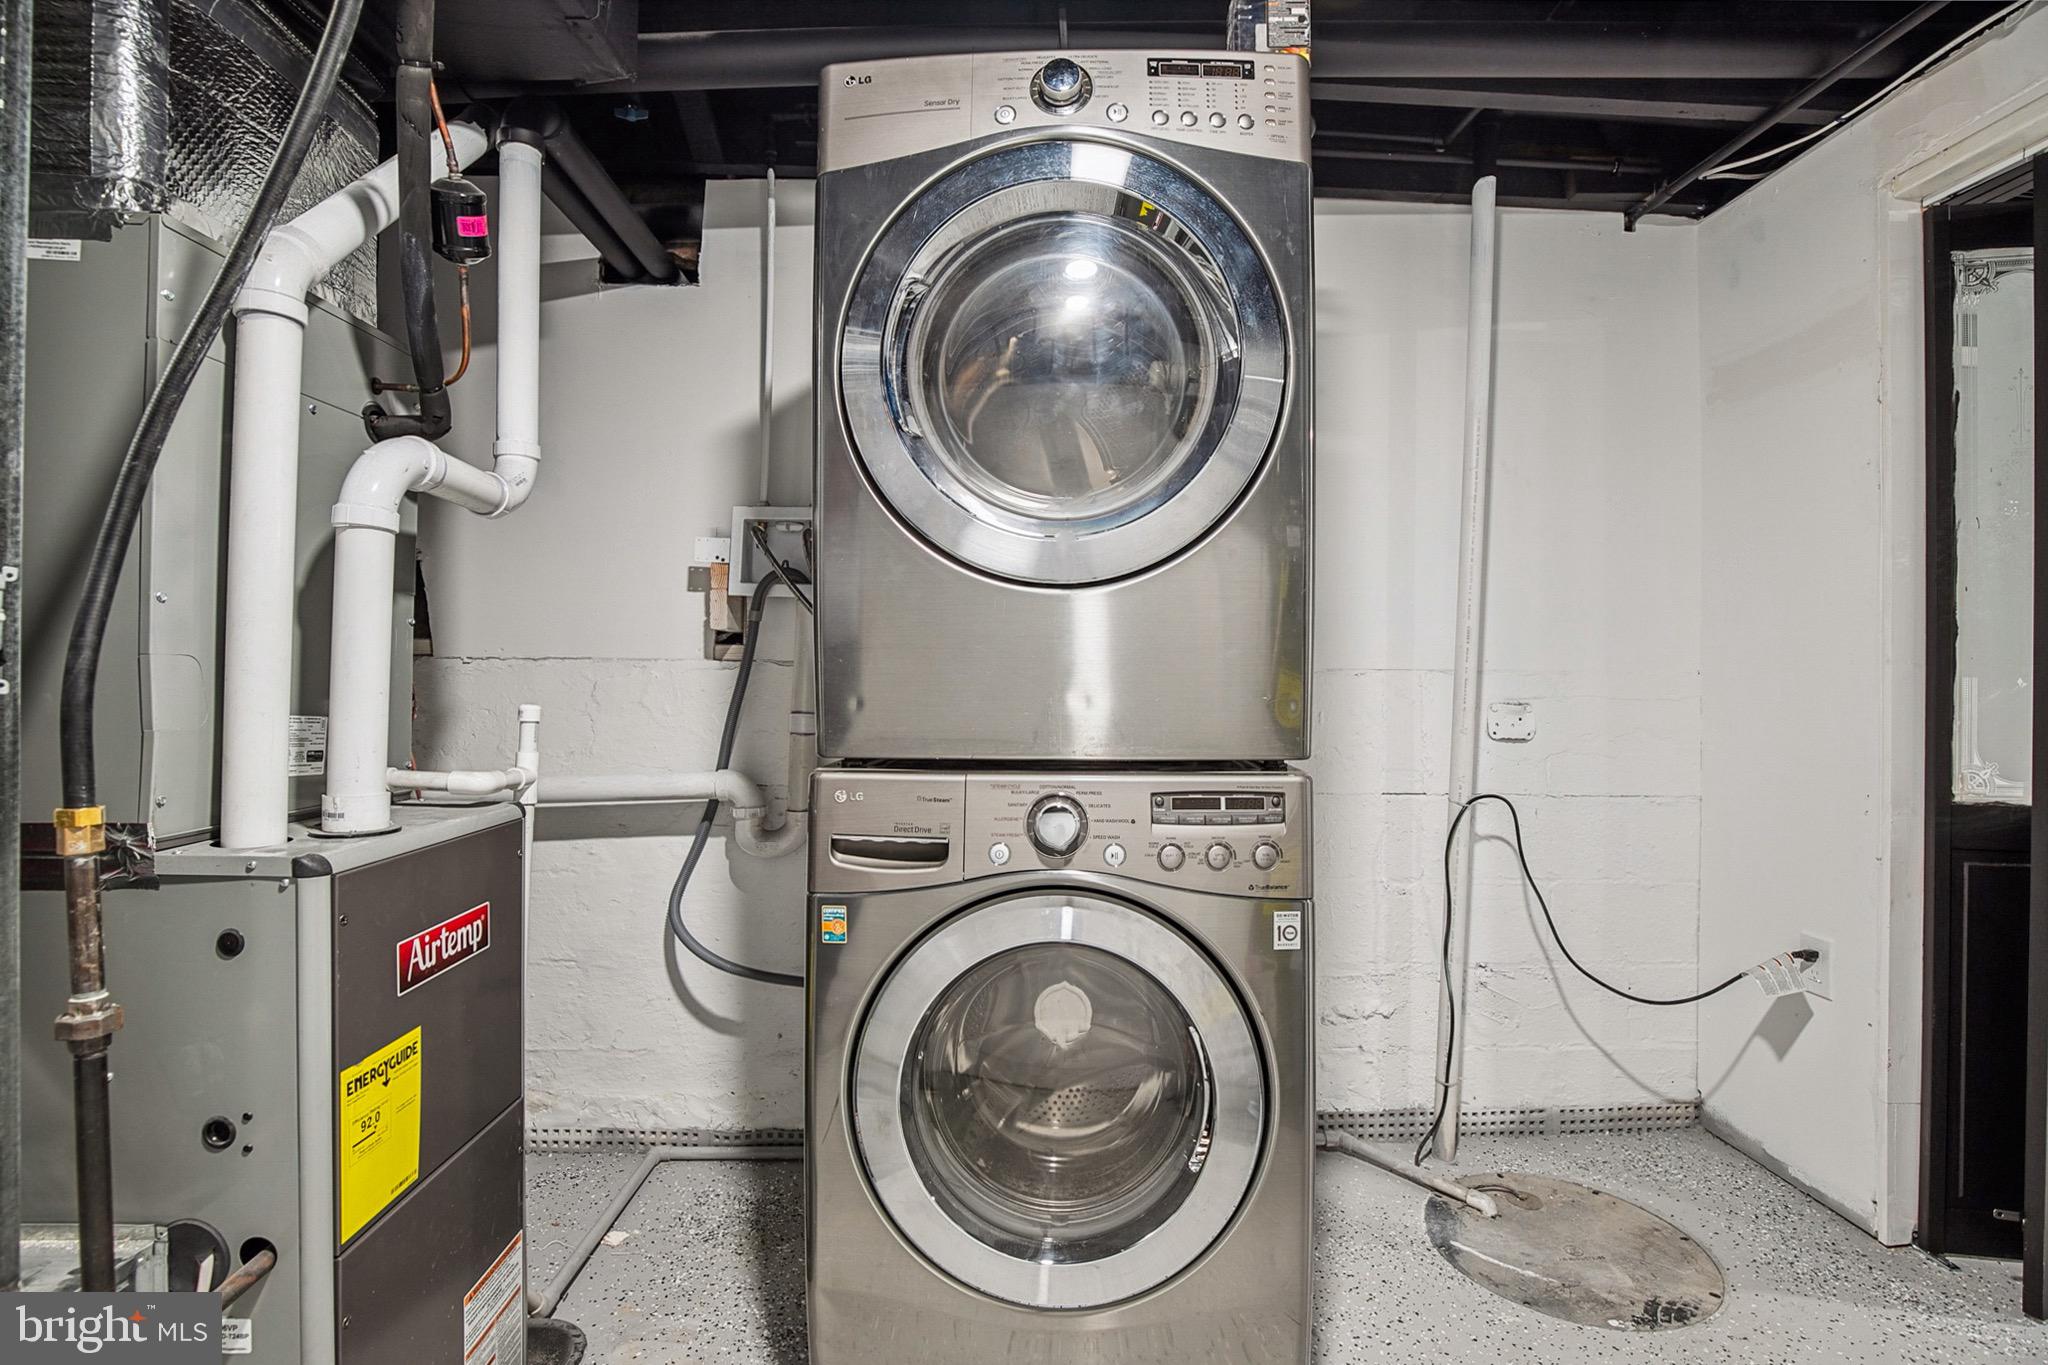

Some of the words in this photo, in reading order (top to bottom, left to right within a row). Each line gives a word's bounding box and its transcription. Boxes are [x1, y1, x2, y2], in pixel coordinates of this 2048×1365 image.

[858, 76, 872, 85] LG
[924, 99, 946, 107] Sensor
[947, 98, 960, 107] Dry
[849, 792, 864, 801] LG
[914, 826, 932, 834] Drive
[408, 919, 483, 982] Airtemp
[346, 1041, 418, 1097] ENERGYGUIDE
[361, 1111, 381, 1133] 92.0
